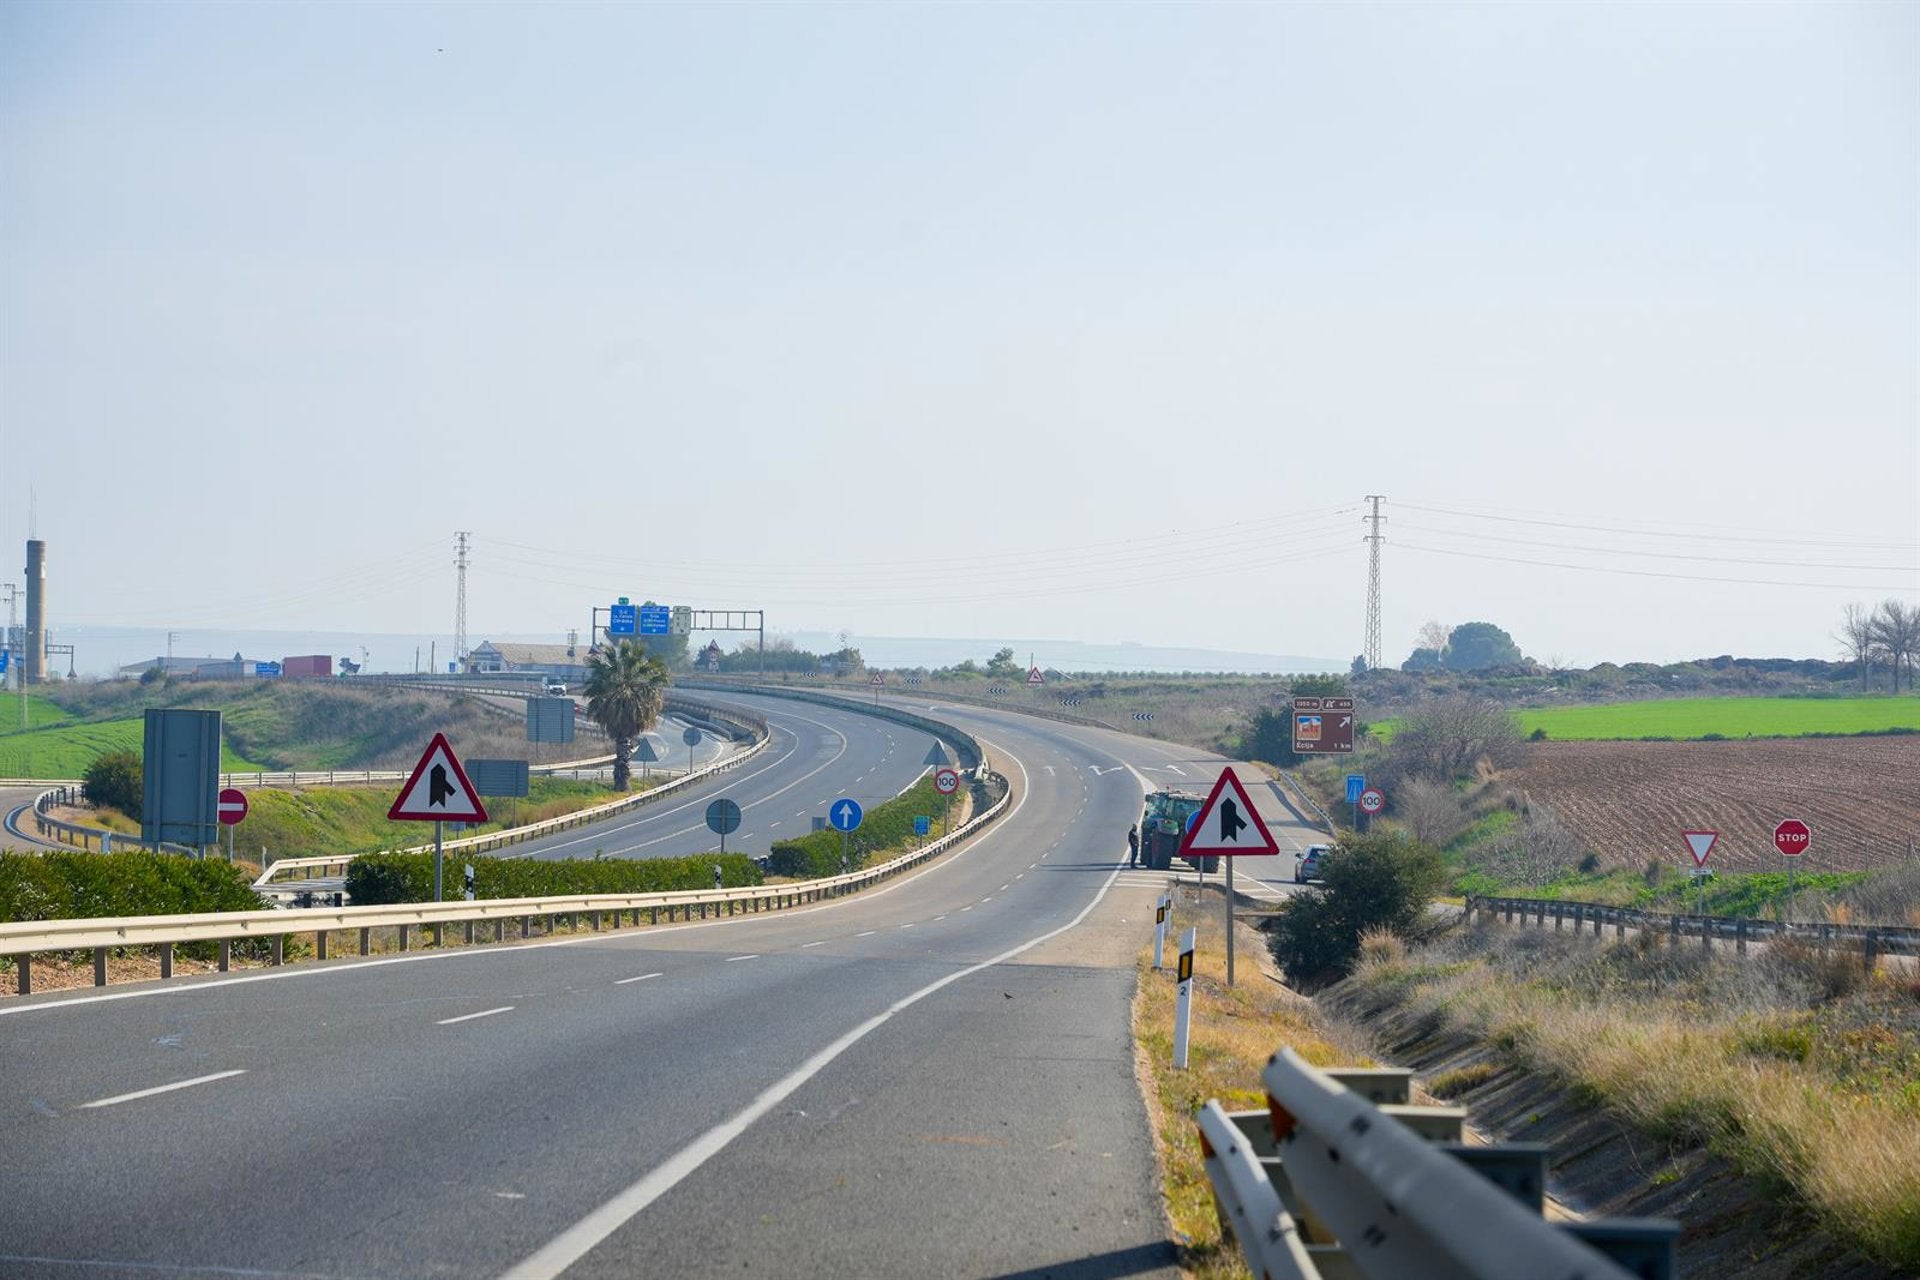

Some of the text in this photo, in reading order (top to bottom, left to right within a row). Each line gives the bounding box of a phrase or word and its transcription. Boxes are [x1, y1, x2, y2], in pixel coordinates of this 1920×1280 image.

[938, 777, 956, 787] 100
[1363, 796, 1380, 806] 100
[1777, 833, 1807, 842] STOP
[1180, 986, 1186, 996] 2
